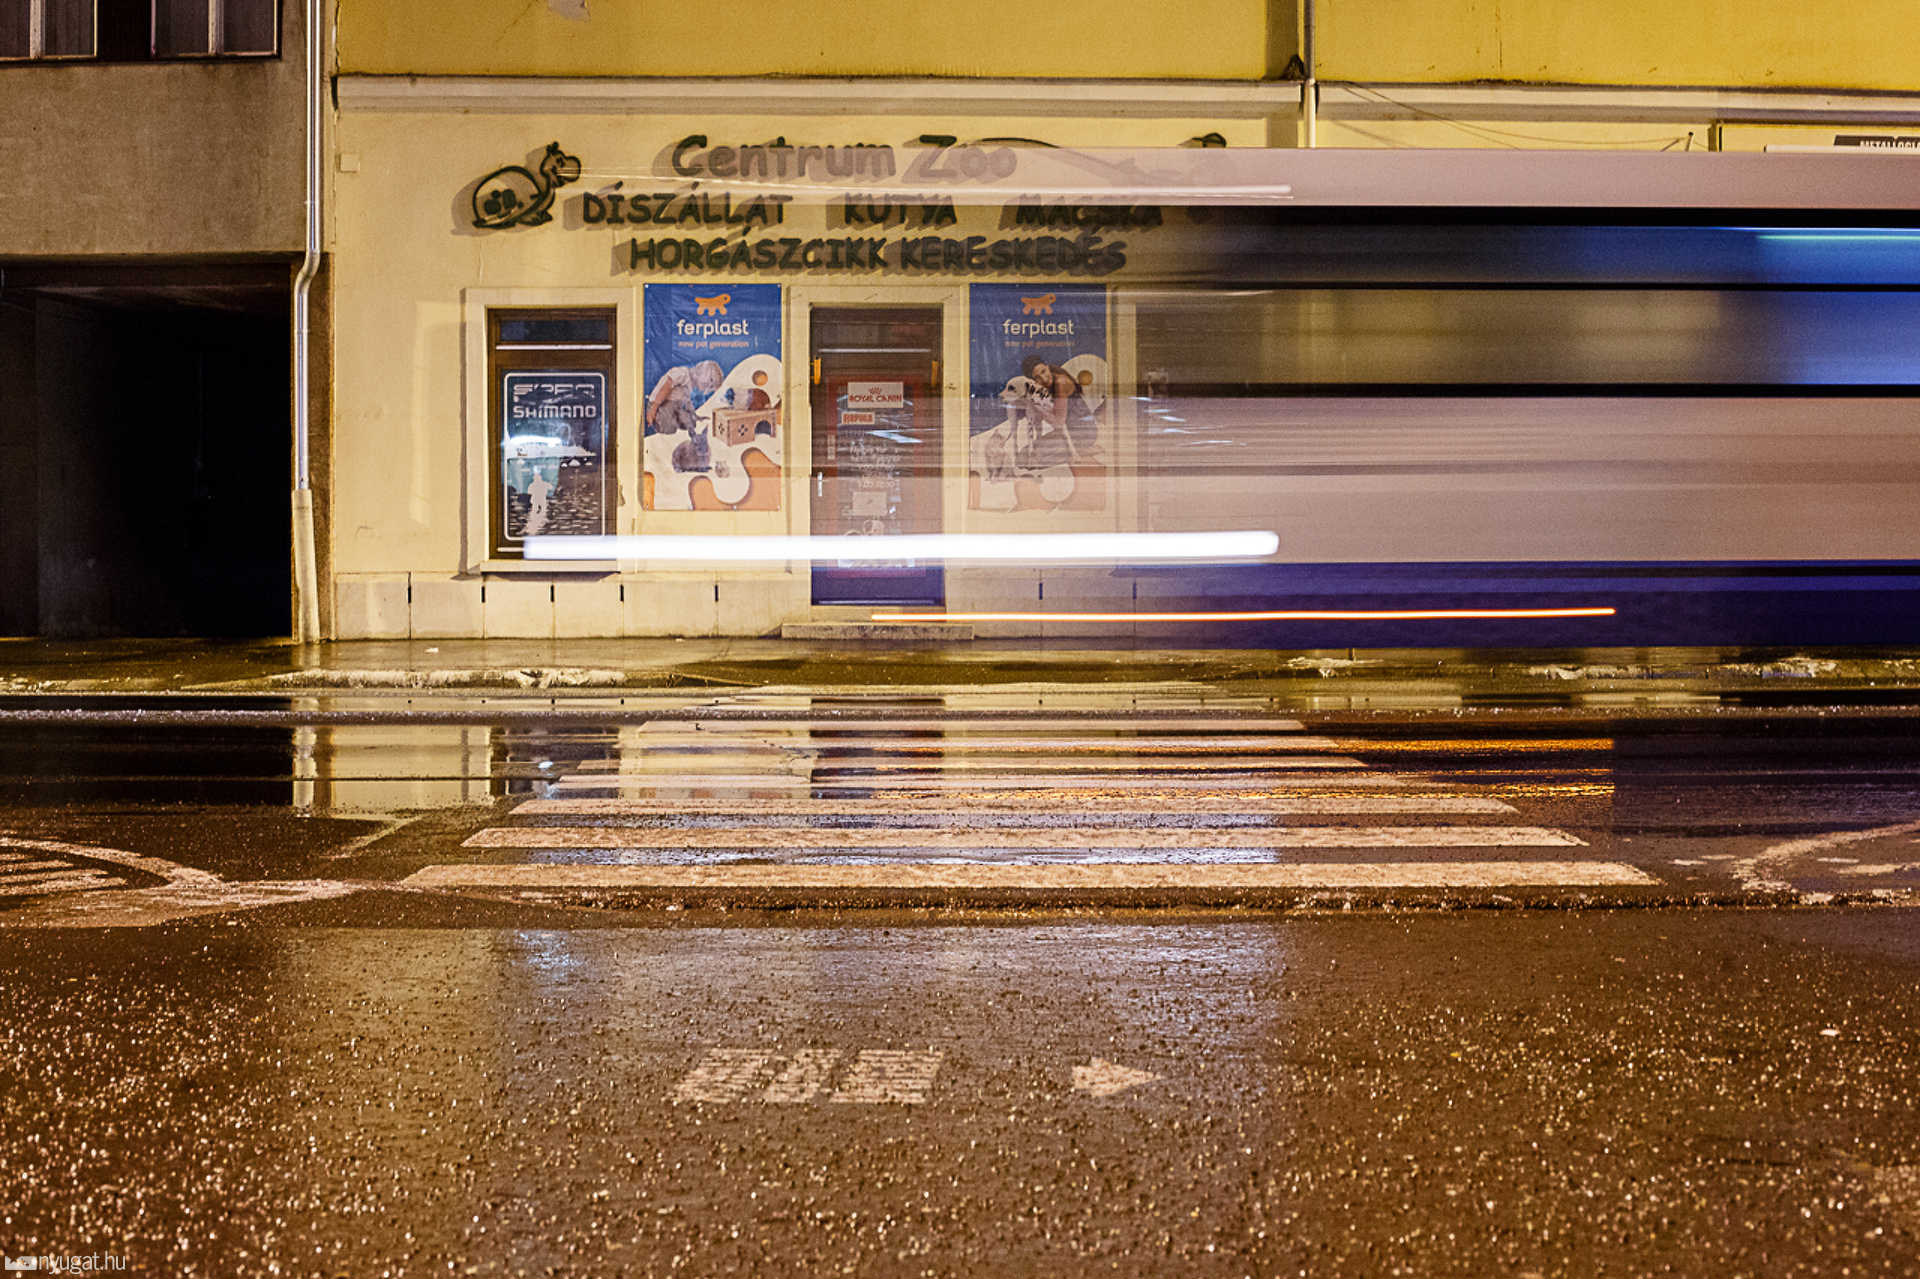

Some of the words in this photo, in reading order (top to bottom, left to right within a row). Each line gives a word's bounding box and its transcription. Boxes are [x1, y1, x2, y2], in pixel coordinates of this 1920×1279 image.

[672, 134, 896, 178] Centrum
[583, 181, 793, 224] DÍSZÁLLAT
[844, 192, 957, 225] KUTYA
[630, 226, 888, 270] HORGÁSZCIKK
[901, 226, 1127, 270] KERESKEDÉS
[676, 319, 750, 339] ferplast
[1002, 319, 1075, 339] ferplast
[513, 405, 597, 418] SHIMANO
